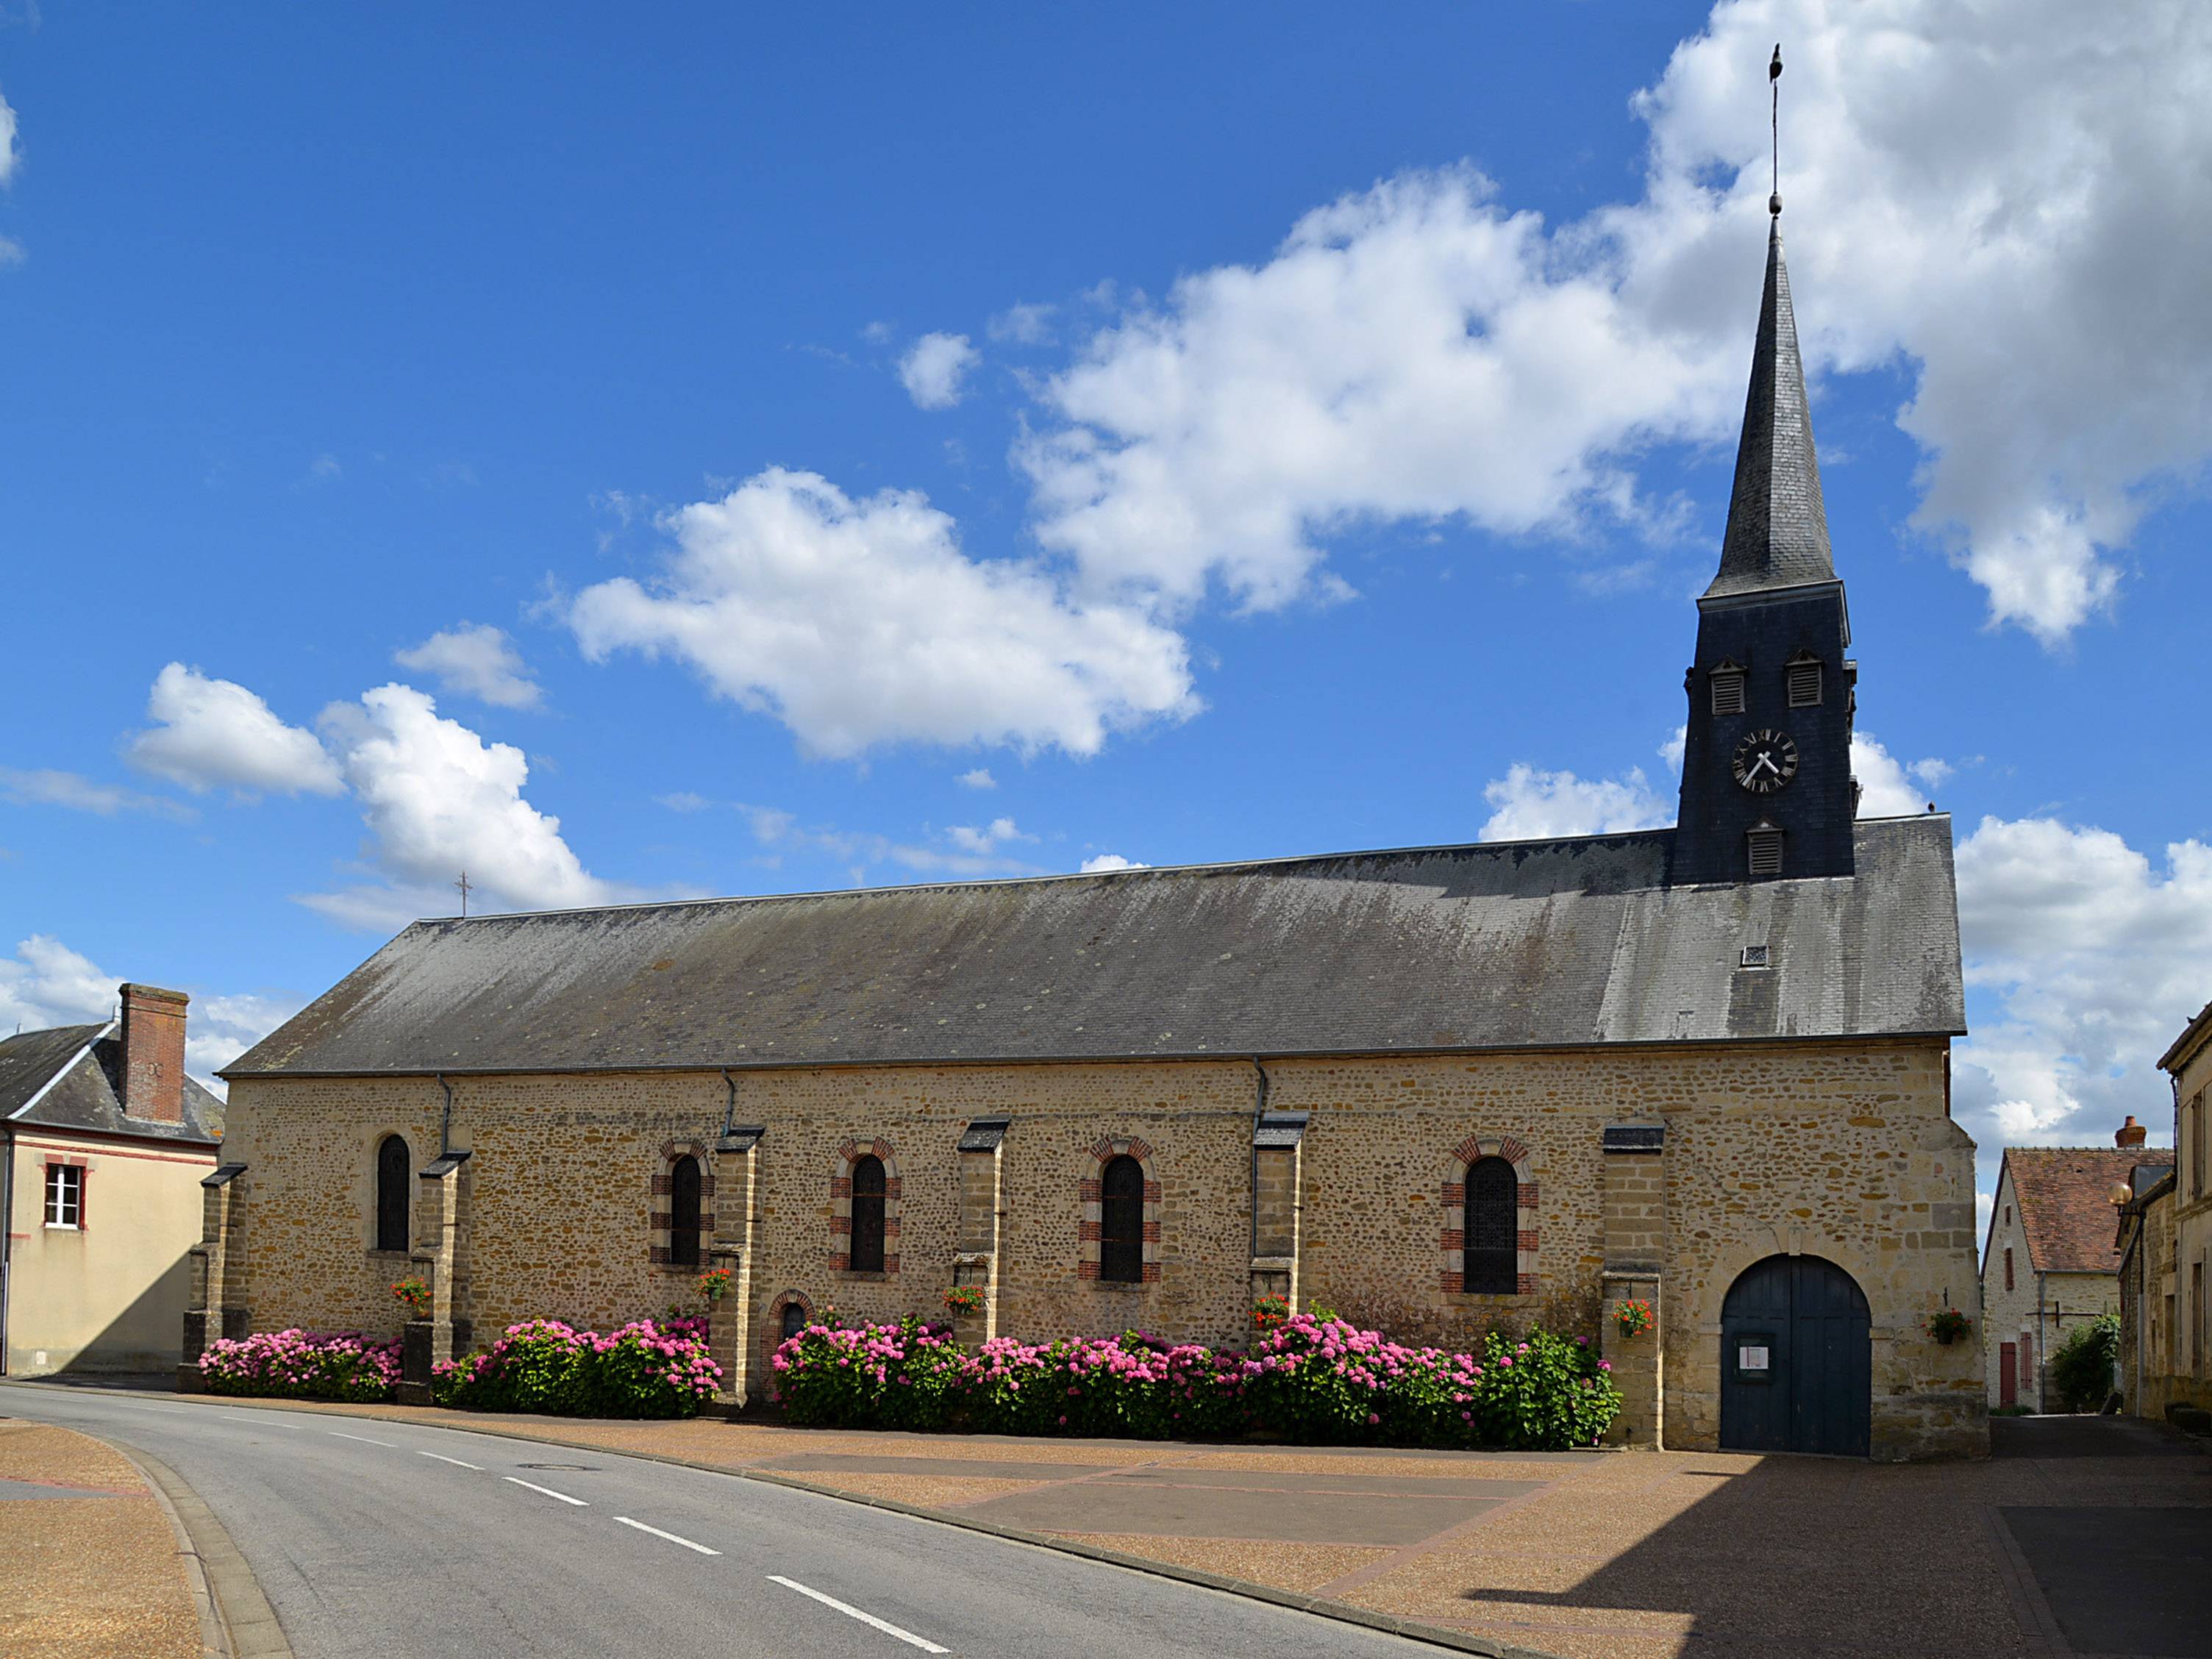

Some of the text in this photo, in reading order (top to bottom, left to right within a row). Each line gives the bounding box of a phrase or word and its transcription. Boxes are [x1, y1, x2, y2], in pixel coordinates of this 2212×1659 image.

[1757, 729, 1771, 741] XII
[1774, 732, 1782, 743] I
[1782, 741, 1794, 751] II
[1785, 754, 1798, 762] III
[1774, 777, 1783, 788] V
